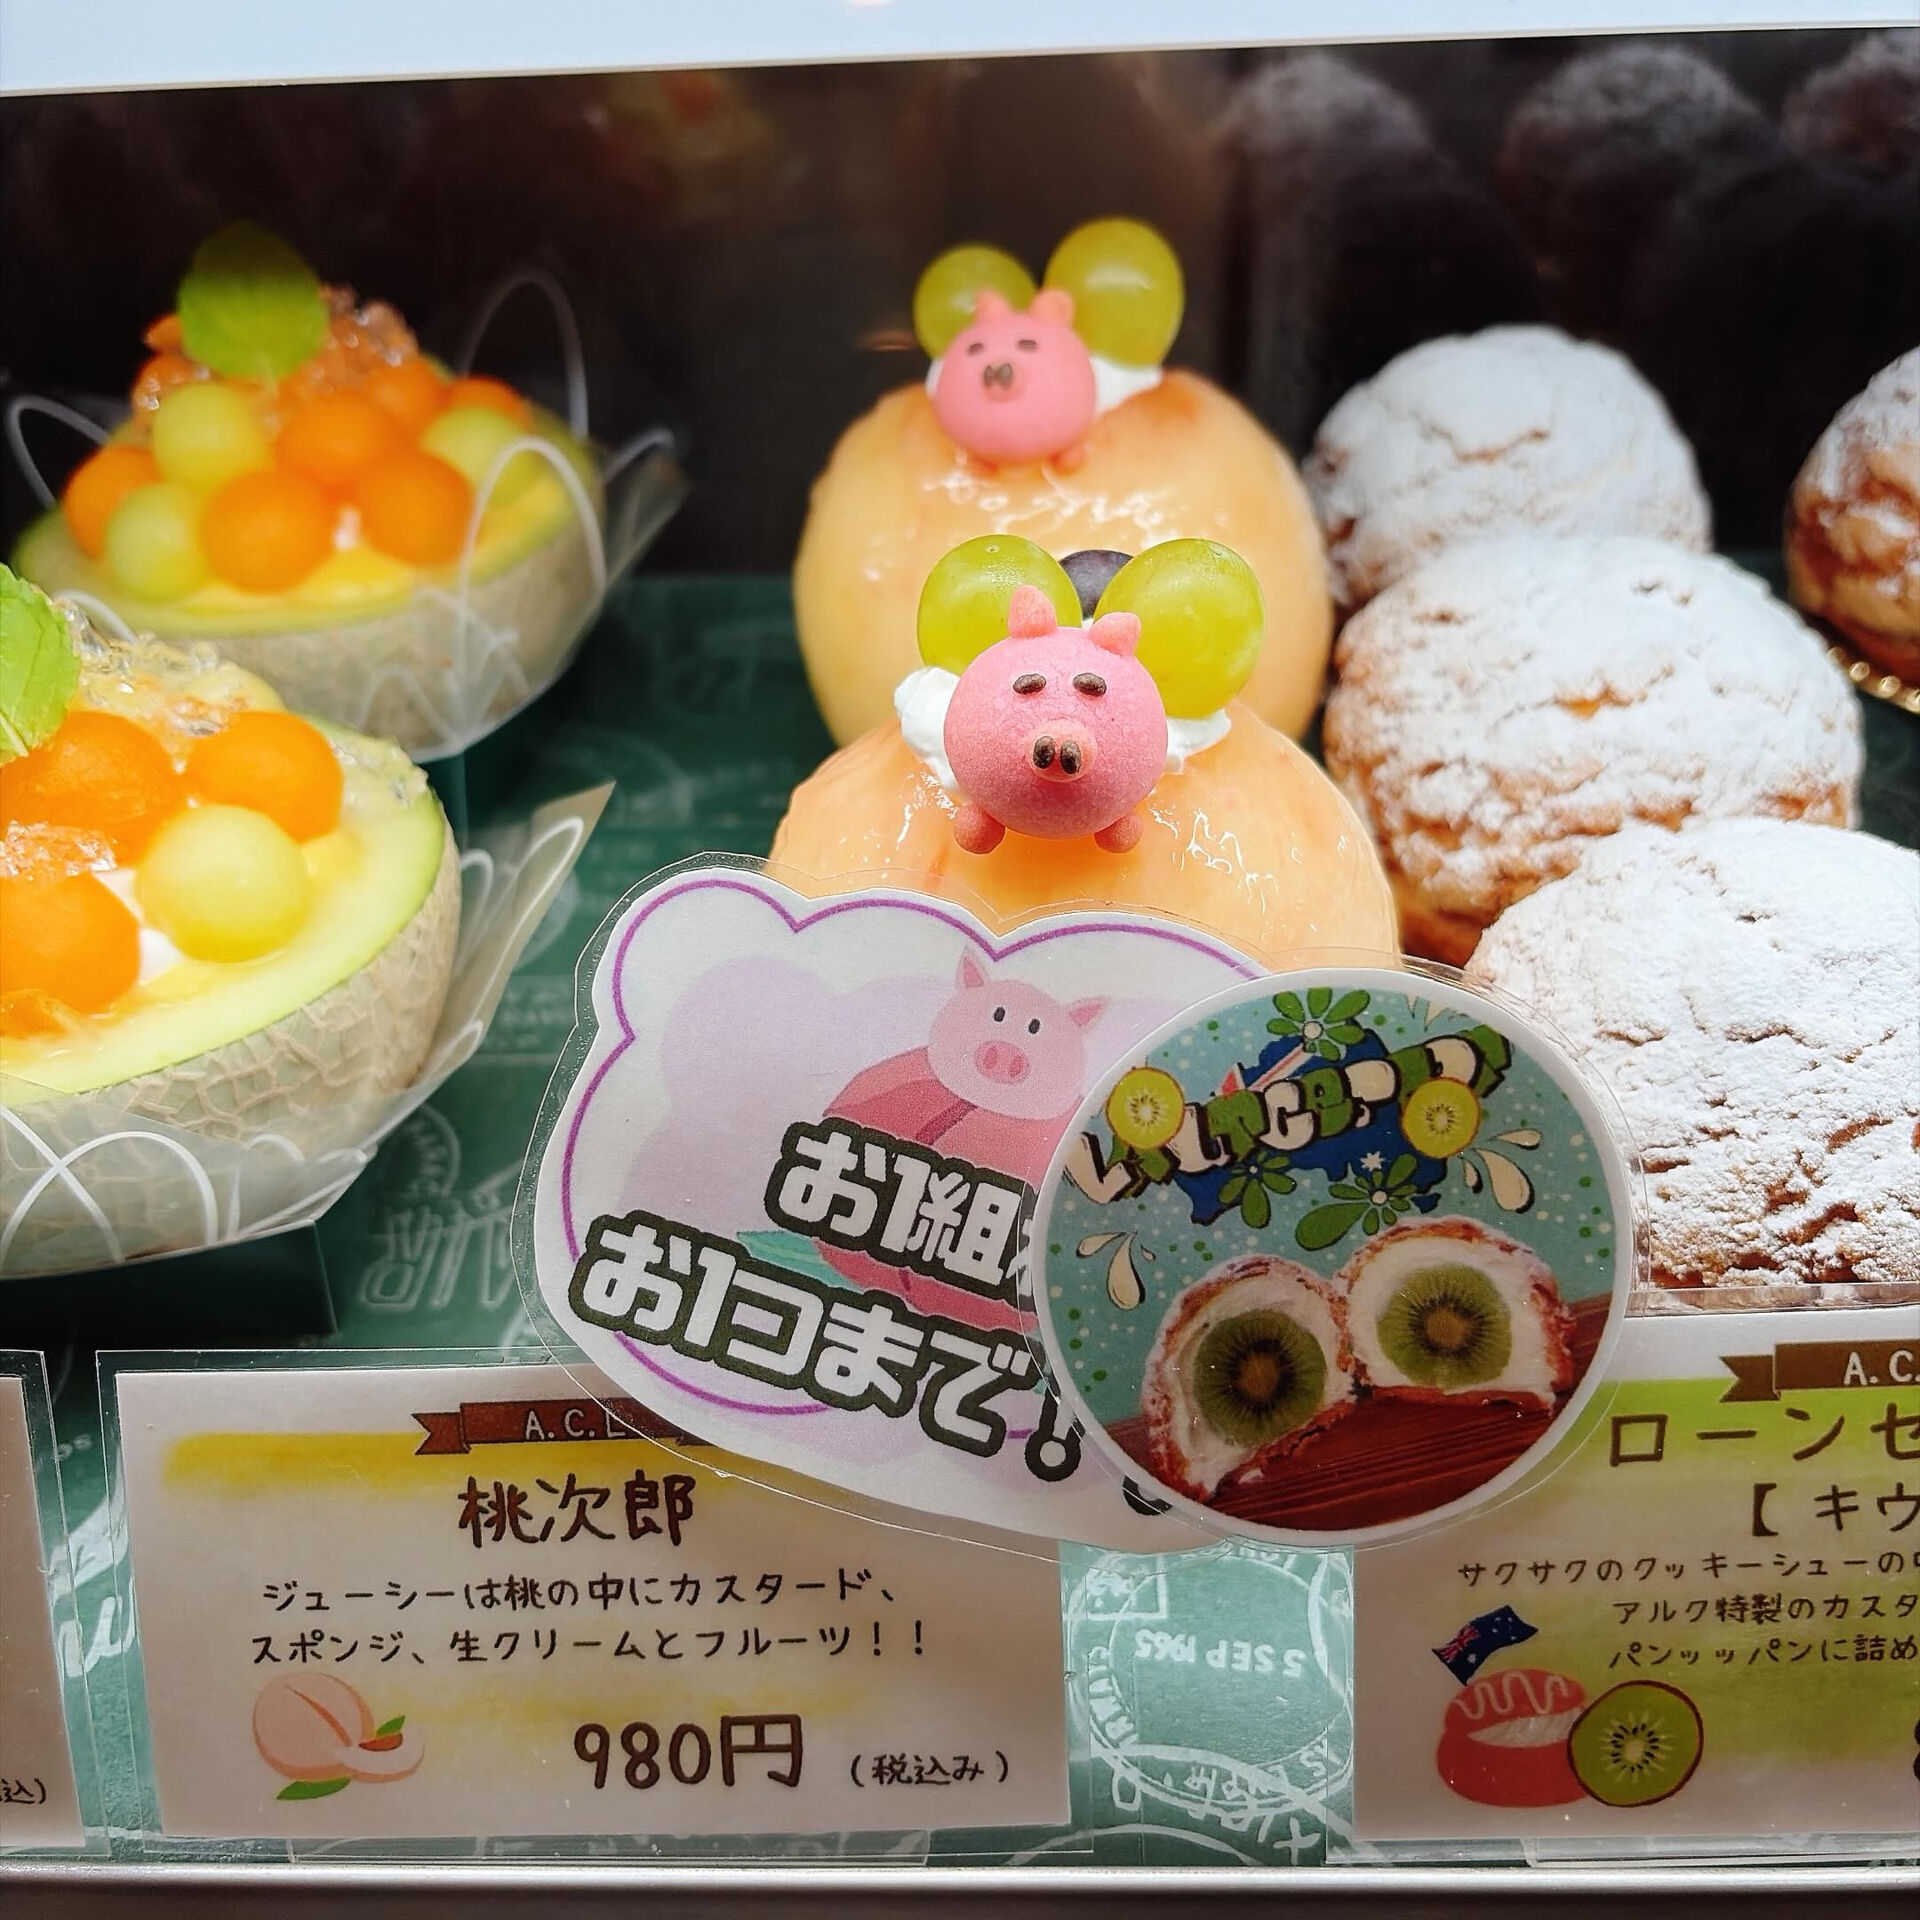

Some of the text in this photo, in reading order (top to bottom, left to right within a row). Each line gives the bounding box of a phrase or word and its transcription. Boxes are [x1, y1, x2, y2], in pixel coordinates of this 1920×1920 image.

[765, 1117, 1037, 1312] お1組
[568, 1210, 1173, 1516] お1コまで!
[1609, 1402, 1920, 1468] ローンセ
[458, 1469, 696, 1549] 桃次郎
[263, 1568, 895, 1612] ジューシーは桃の中にカスタード、
[1611, 1593, 1919, 1625] アルク特製のカスタ
[574, 1713, 1010, 1790] 980円 (税込み)
